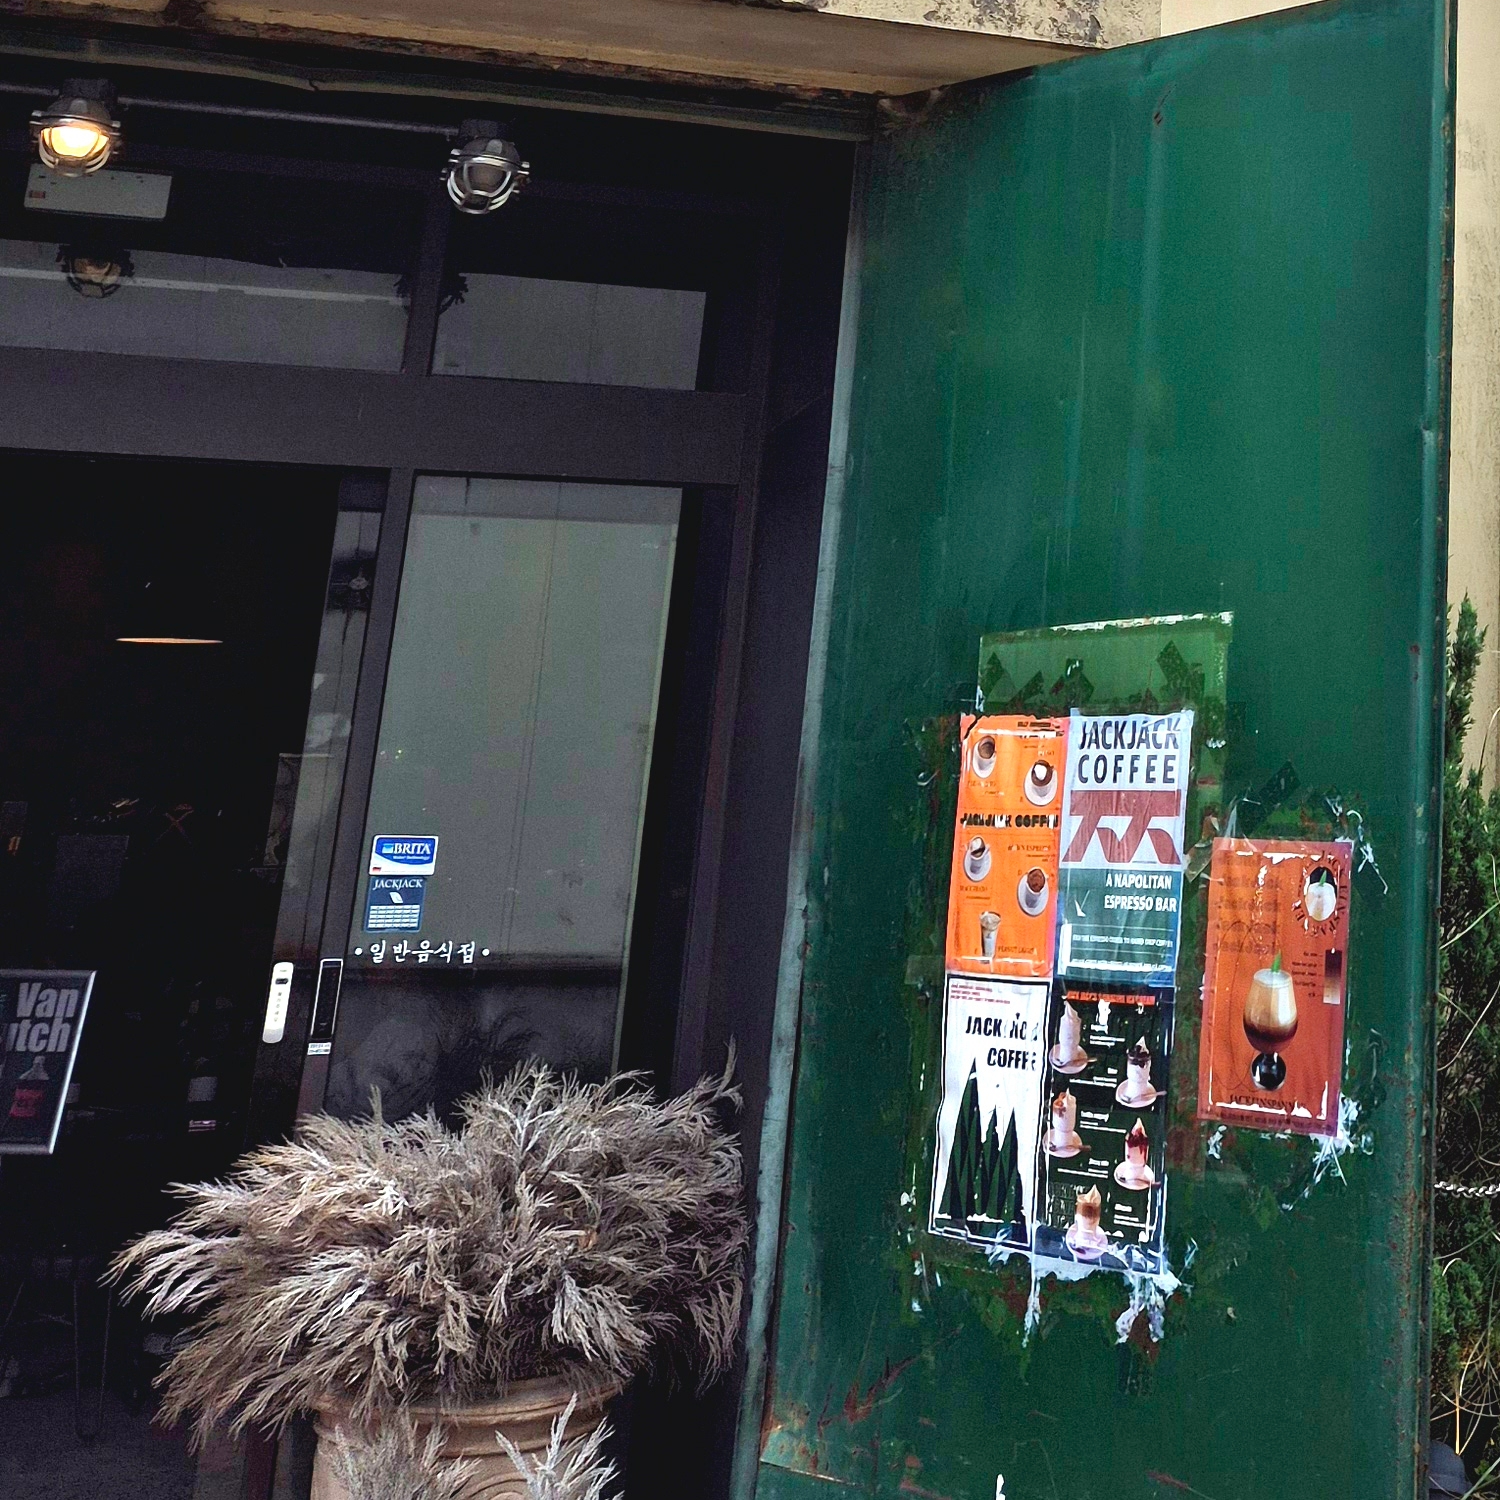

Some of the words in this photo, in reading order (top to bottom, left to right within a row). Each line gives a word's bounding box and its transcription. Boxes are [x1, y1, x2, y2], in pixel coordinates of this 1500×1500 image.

[1078, 717, 1181, 750] JACKJACK
[1077, 754, 1177, 784] COFFEE
[960, 812, 1013, 828] JACKJK
[1015, 814, 1059, 829] COFF
[393, 842, 431, 855] BRITA
[372, 878, 424, 891] JACKJACK
[1105, 873, 1113, 887] A
[1113, 873, 1173, 890] NAPOLITAN
[1104, 894, 1154, 911] ESPRESSO
[1155, 897, 1177, 913] BAR
[370, 939, 476, 964] 일반음식점
[16, 981, 79, 1018] Van
